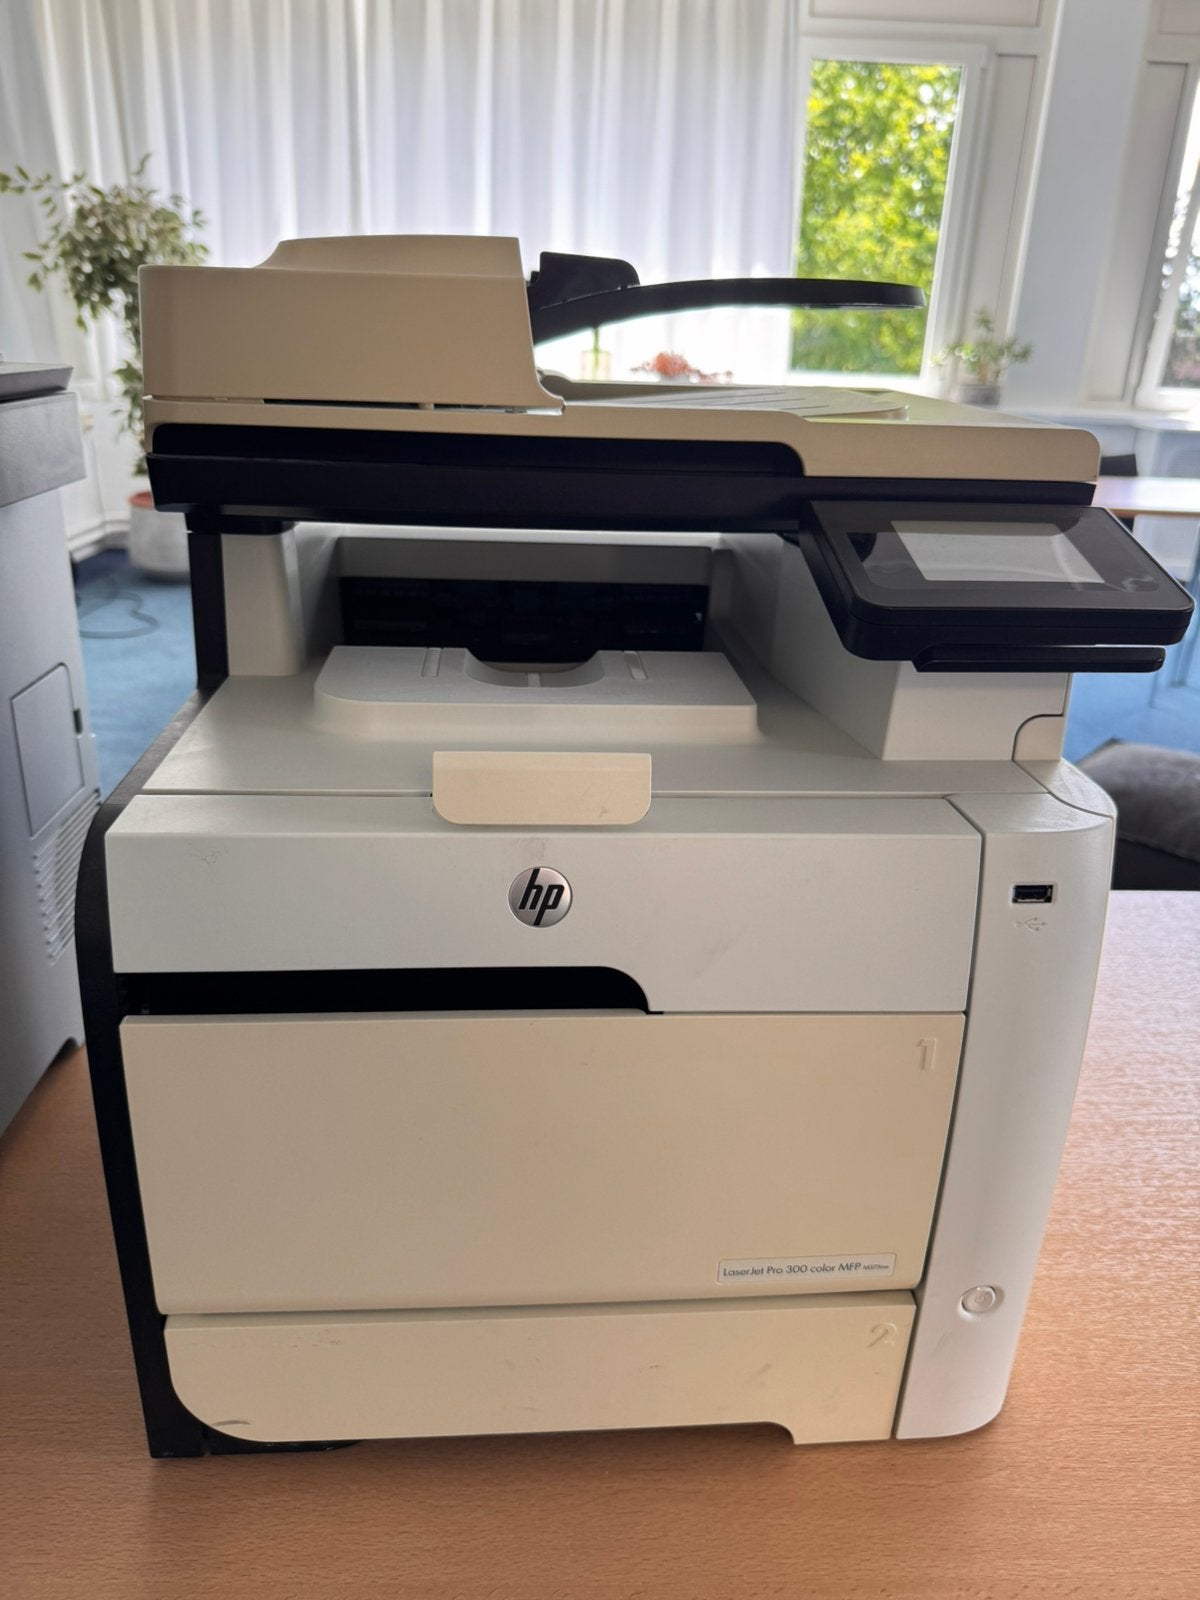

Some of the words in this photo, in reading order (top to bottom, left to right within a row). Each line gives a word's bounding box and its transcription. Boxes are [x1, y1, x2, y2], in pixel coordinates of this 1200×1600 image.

[518, 867, 565, 926] hp
[916, 1037, 938, 1071] 1
[722, 1267, 764, 1277] LaserJet
[766, 1265, 783, 1275] Pro
[785, 1264, 808, 1274] 300
[810, 1263, 836, 1273] color
[838, 1262, 861, 1272] MFP
[866, 1322, 897, 1348] 2
